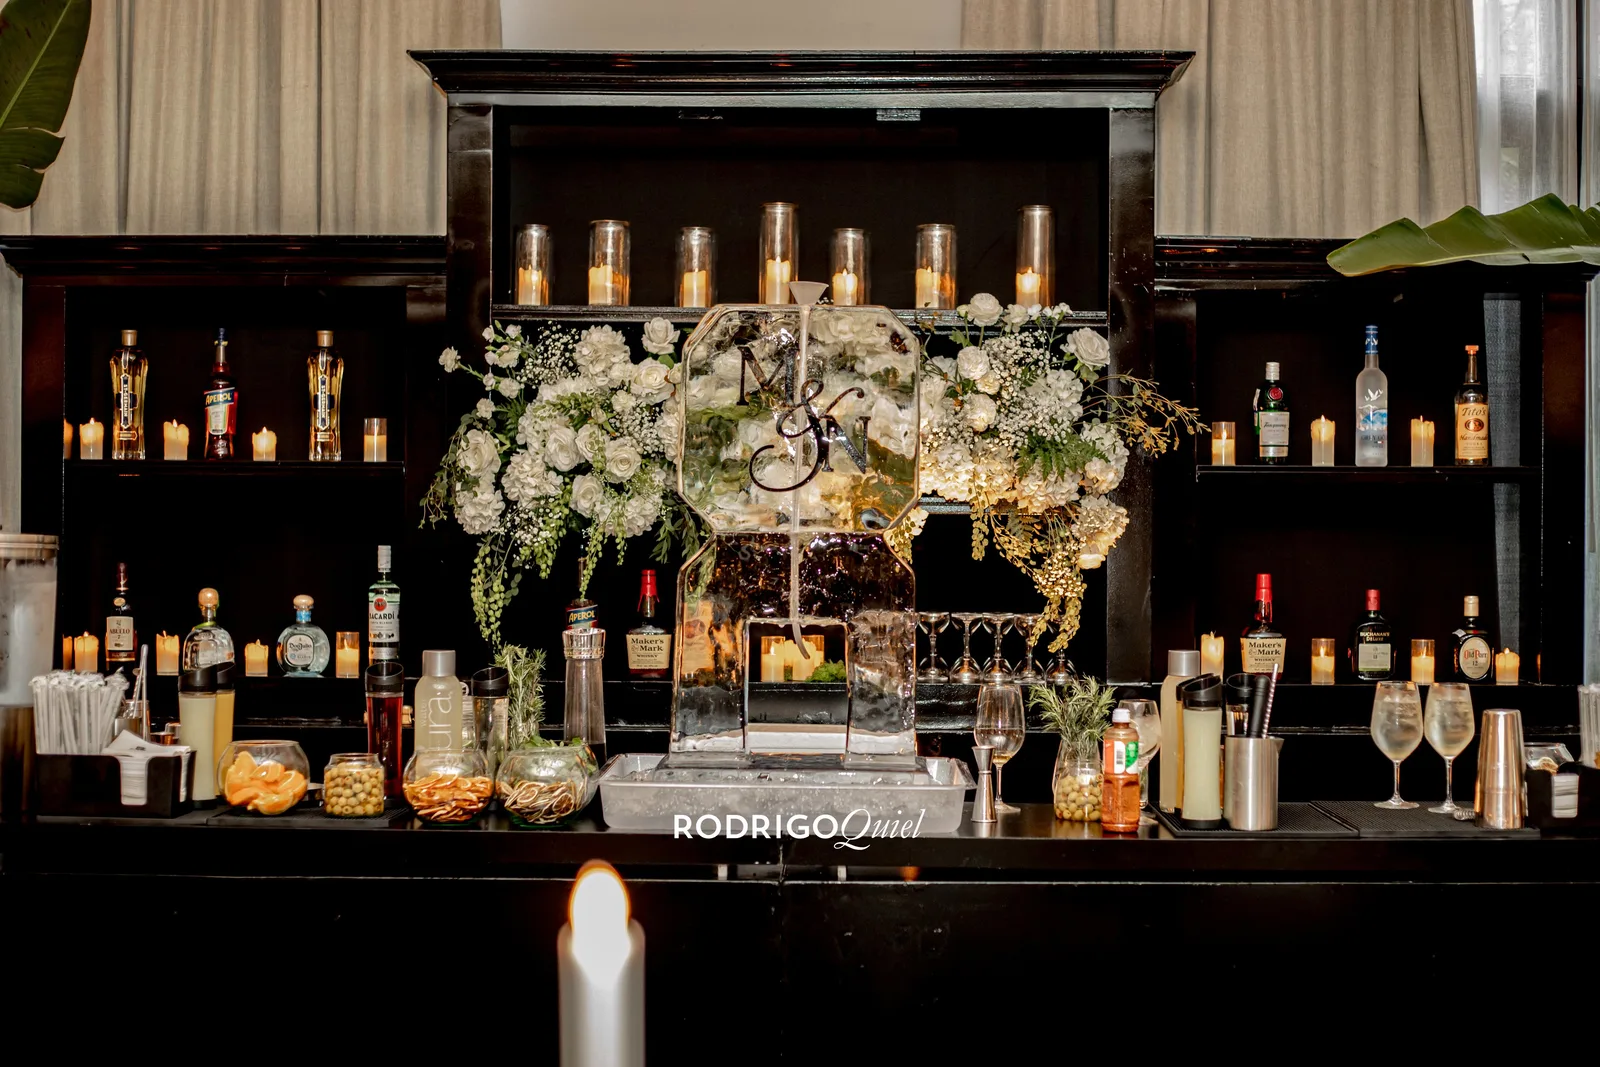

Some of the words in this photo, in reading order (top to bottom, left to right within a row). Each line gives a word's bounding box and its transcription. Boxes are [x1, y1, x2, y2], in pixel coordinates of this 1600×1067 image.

[205, 392, 232, 405] APEROL
[1462, 407, 1487, 416] Tito's
[569, 610, 595, 623] APEROL
